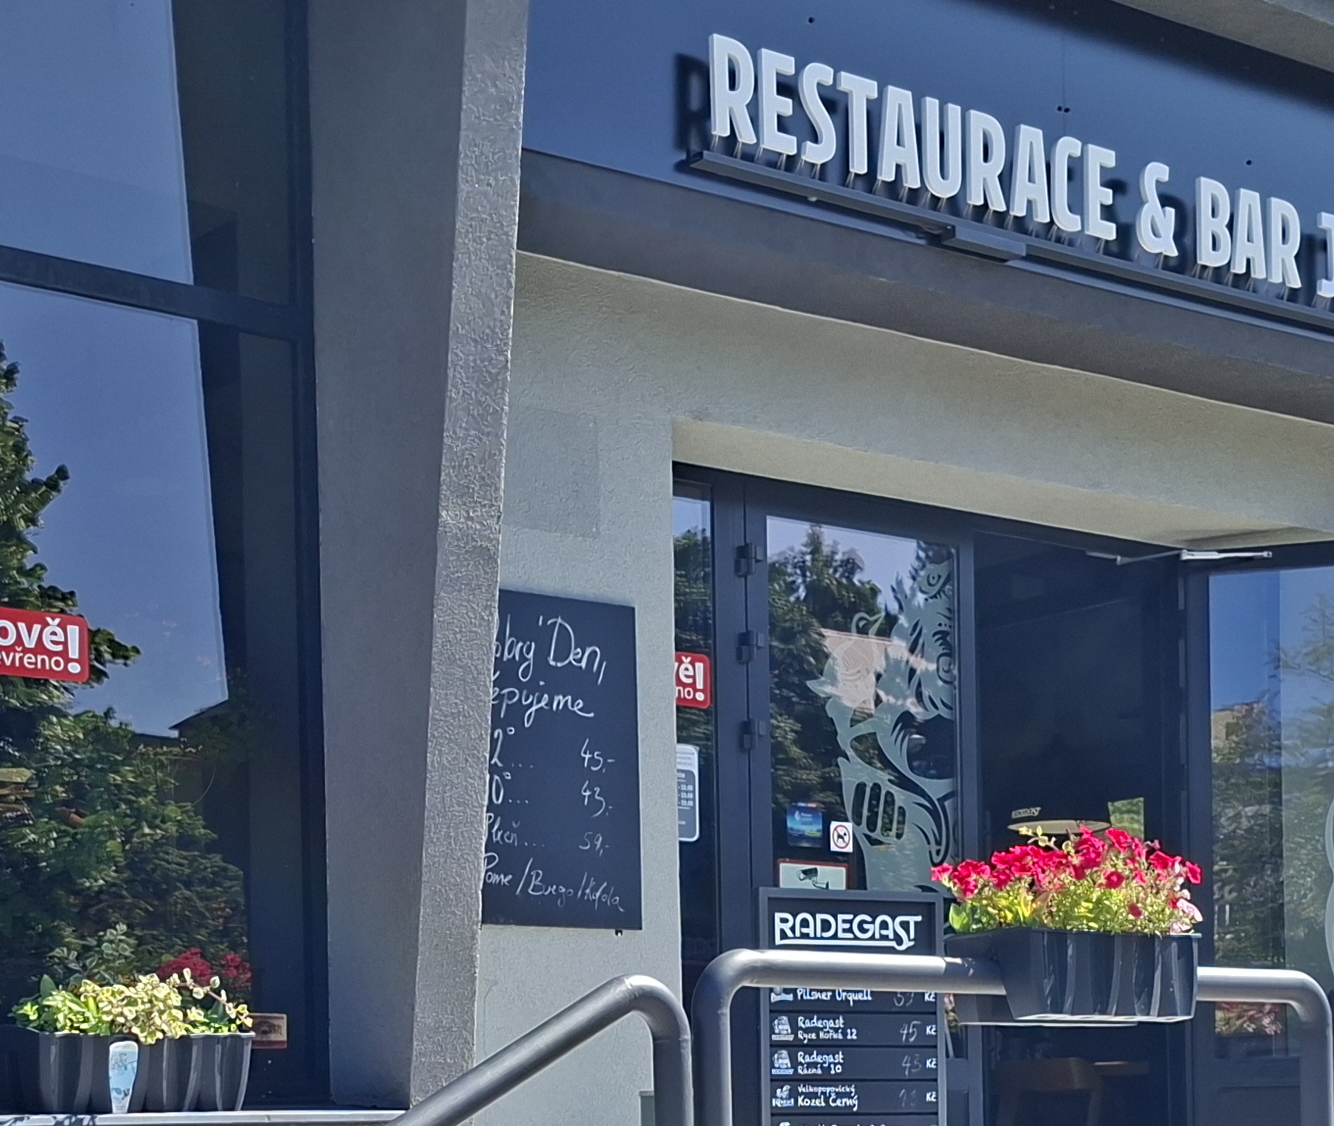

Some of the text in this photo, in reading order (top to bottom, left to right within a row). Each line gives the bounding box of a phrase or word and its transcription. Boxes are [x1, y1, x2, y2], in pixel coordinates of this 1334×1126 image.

[708, 33, 1117, 241] RESTAURACE
[1136, 161, 1180, 257] &
[1195, 176, 1302, 289] BAR
[490, 670, 595, 729] epujeme
[774, 911, 923, 951] RADEGAST
[796, 987, 833, 1001] Pilsner
[835, 988, 873, 1007] Urquell
[797, 1015, 845, 1032] Radegast
[846, 1028, 858, 1040] 12
[899, 1020, 922, 1043] 45
[925, 1025, 937, 1036] Kč
[797, 1050, 845, 1067] Radegast
[830, 1063, 843, 1074] 10
[925, 1058, 937, 1069] Kč
[797, 1083, 856, 1096] Velkopopovický
[797, 1094, 826, 1107] Kozel
[829, 1092, 859, 1112] Černý
[925, 1091, 937, 1102] Kč
